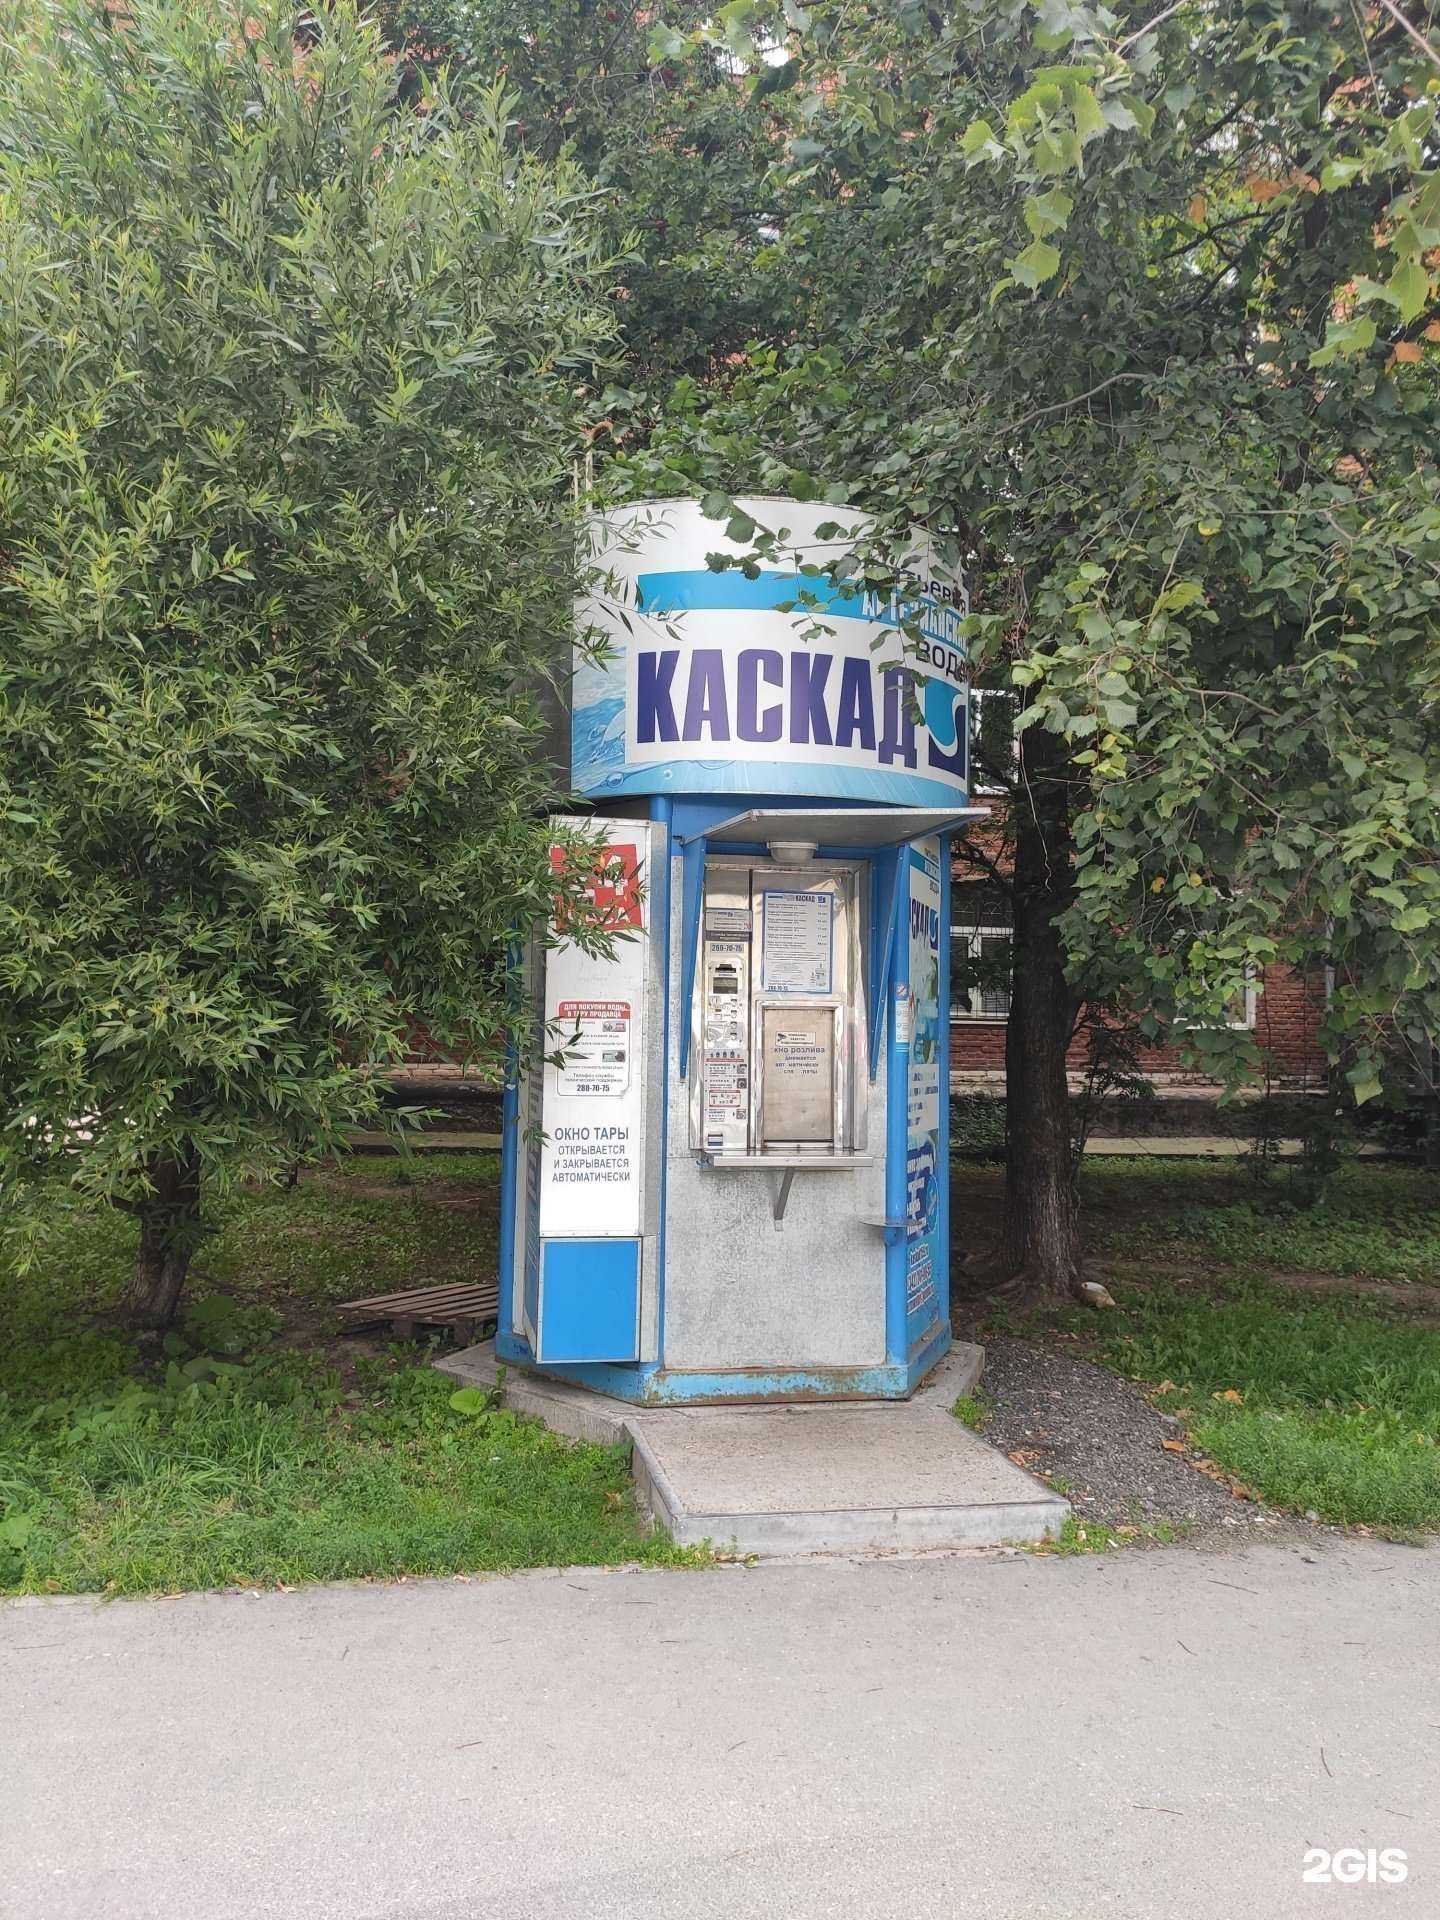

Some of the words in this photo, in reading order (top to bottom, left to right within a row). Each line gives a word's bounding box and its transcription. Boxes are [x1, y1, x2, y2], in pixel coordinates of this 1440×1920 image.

[636, 648, 918, 770] КАСКАД
[564, 1003, 577, 1011] ДЛЯ
[578, 1003, 607, 1011] ПОКУПКИ
[607, 1003, 626, 1011] ВОДЫ
[589, 1010, 622, 1018] ПРОДАВЦА
[554, 1127, 590, 1141] ОКНО
[593, 1127, 629, 1140] ТАРЫ
[558, 1145, 625, 1155] ОТКРЫВАЕТСЯ
[553, 1159, 560, 1168] И
[562, 1158, 629, 1168] ЗАКРЫВАЕТСЯ
[552, 1172, 630, 1182] АВТОМАТИЧЕСКИ
